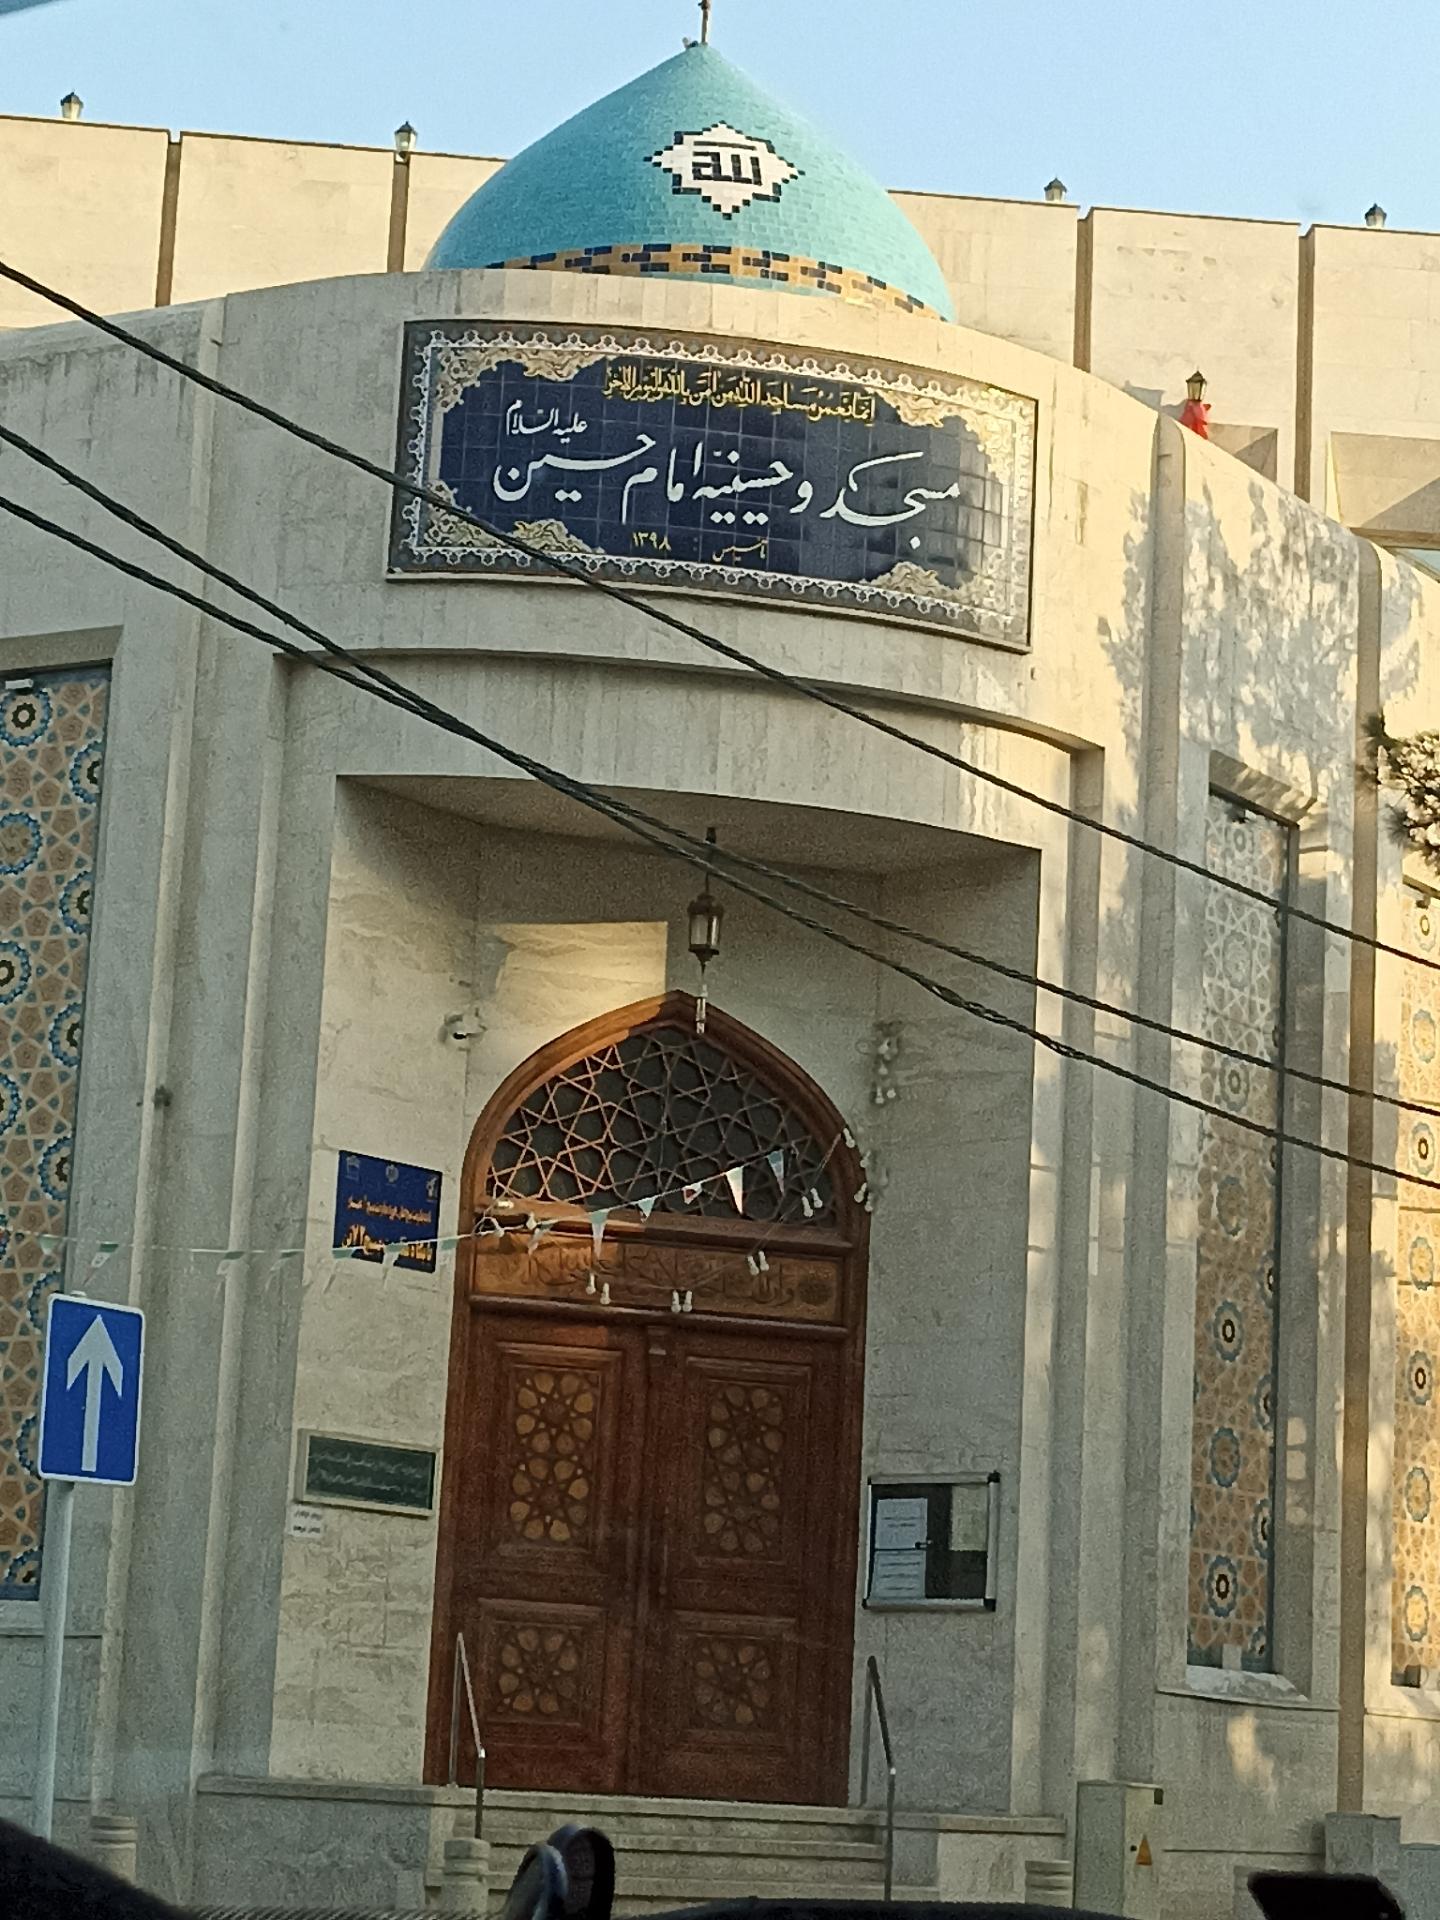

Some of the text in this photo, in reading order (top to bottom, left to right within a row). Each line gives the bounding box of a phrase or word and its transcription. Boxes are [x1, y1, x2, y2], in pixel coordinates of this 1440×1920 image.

[506, 399, 559, 436] السلام
[493, 433, 961, 550] مسجد و حسینیه امام حسین
[632, 531, 672, 551] ۱۳۹۸
